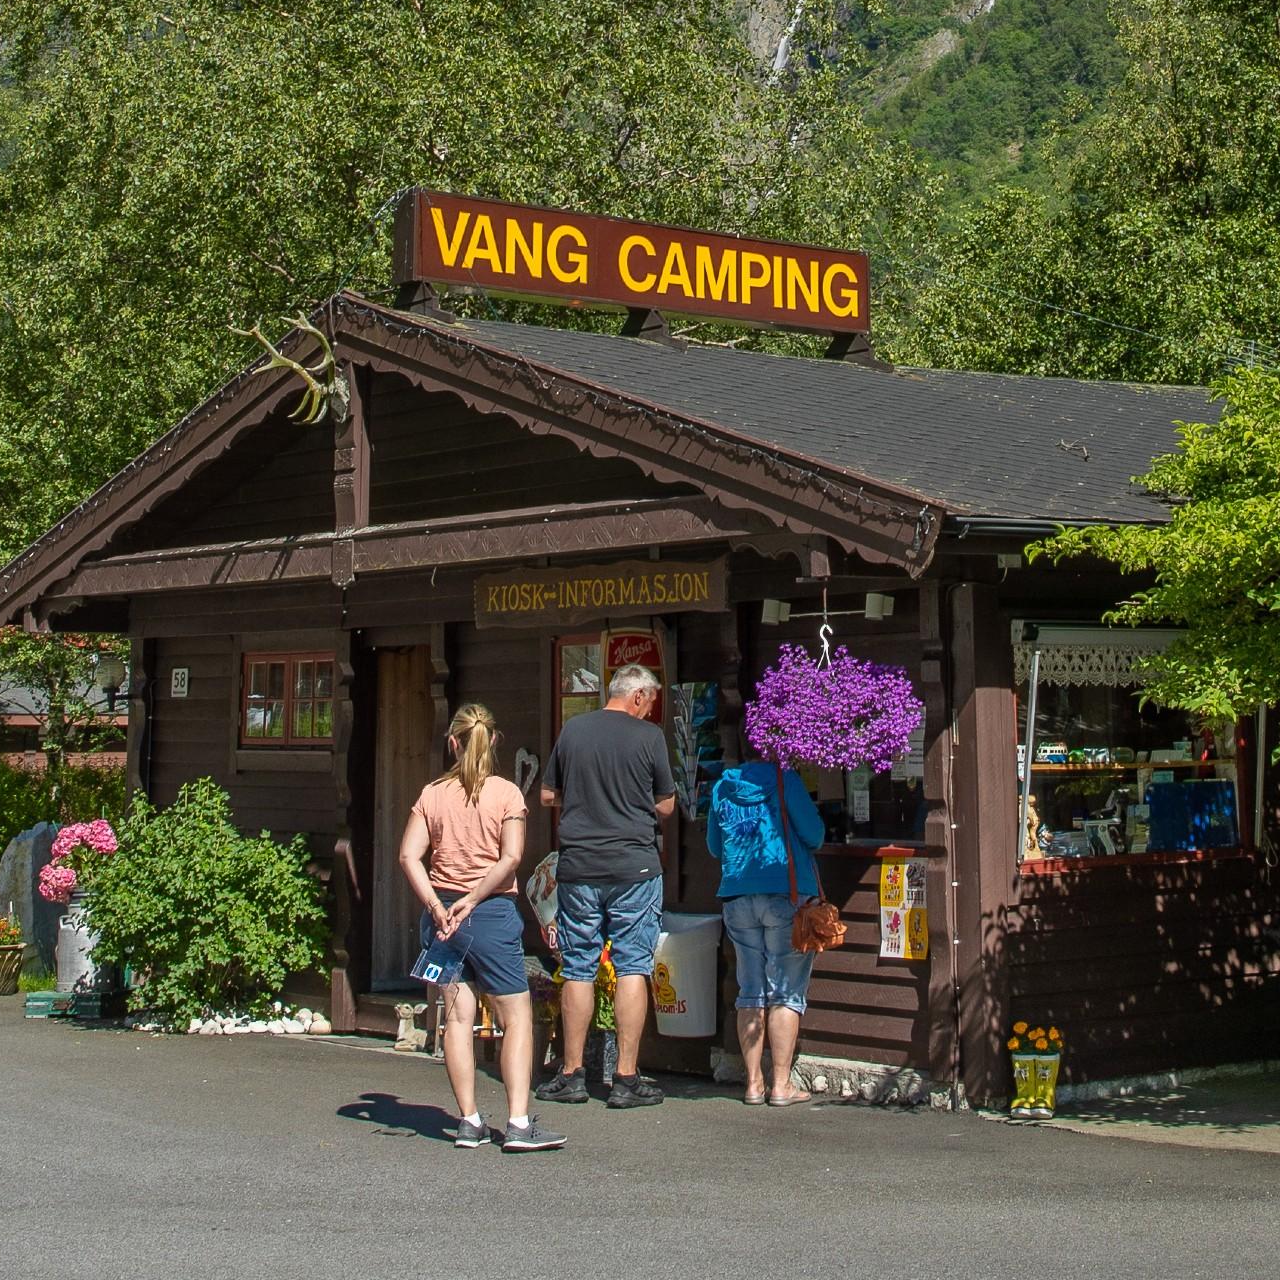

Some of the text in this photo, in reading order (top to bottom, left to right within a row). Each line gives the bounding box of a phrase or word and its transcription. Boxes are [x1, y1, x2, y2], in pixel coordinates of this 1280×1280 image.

[431, 207, 859, 317] VANG CAMPING
[614, 638, 652, 665] Hansa
[174, 671, 186, 688] 58
